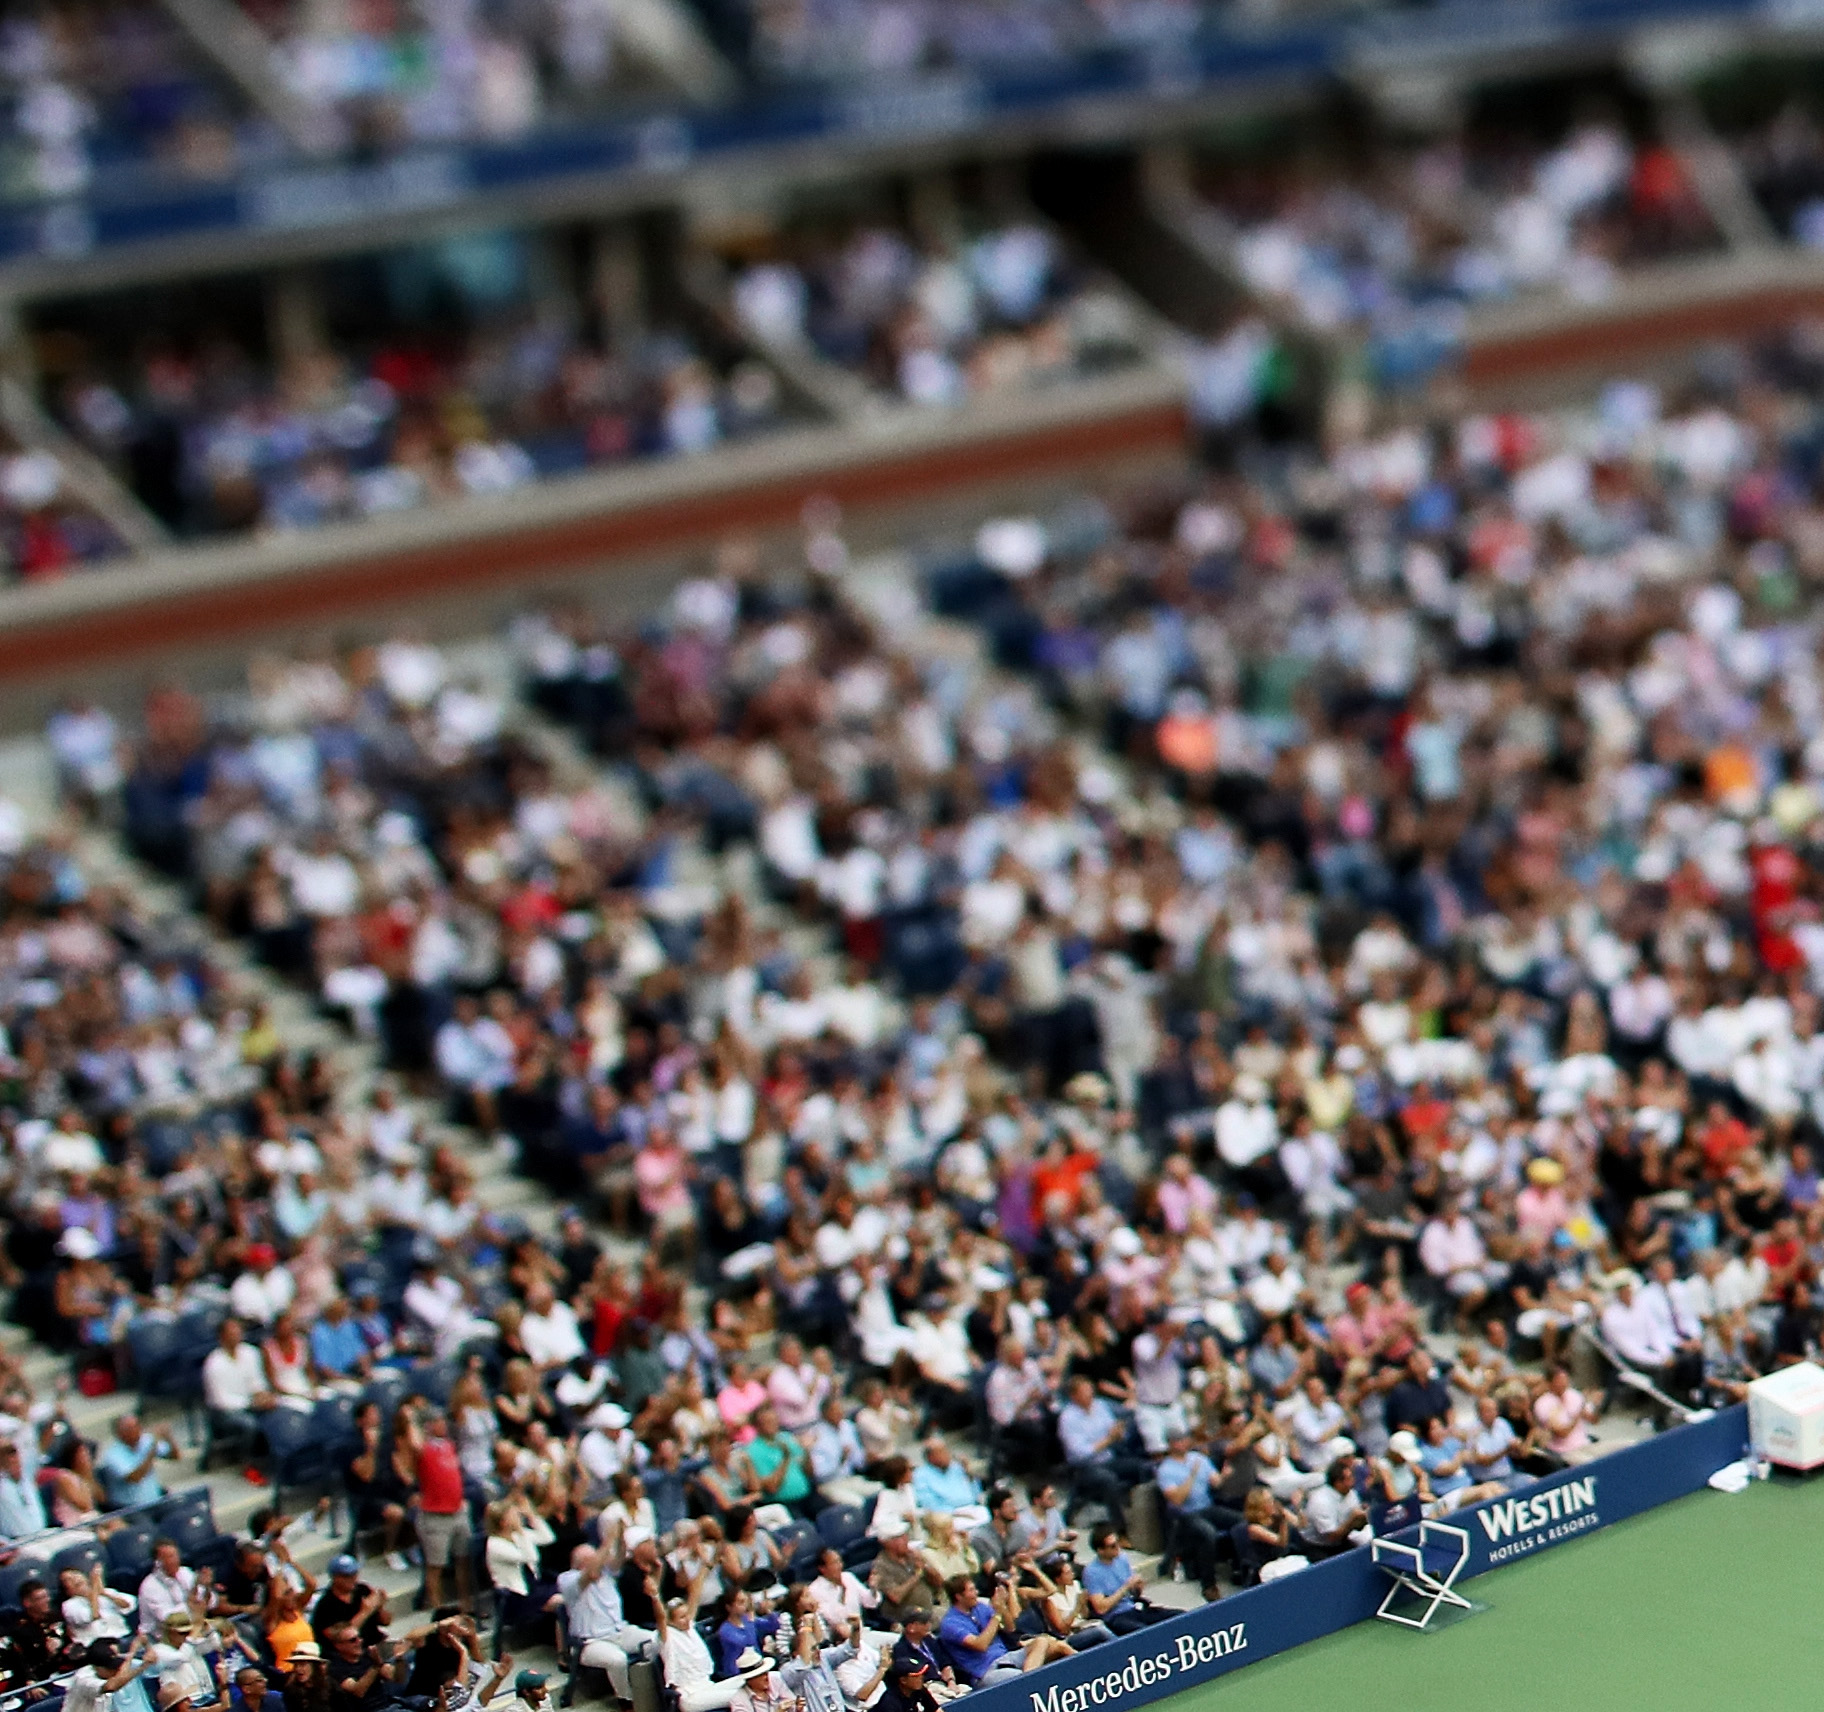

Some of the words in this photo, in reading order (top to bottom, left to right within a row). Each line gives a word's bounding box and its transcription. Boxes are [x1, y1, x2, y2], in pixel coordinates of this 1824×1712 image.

[1477, 1476, 1596, 1542] WESTIN
[1490, 1536, 1535, 1563] HOTELS
[1537, 1532, 1547, 1545] &
[1549, 1513, 1599, 1541] RESORTS
